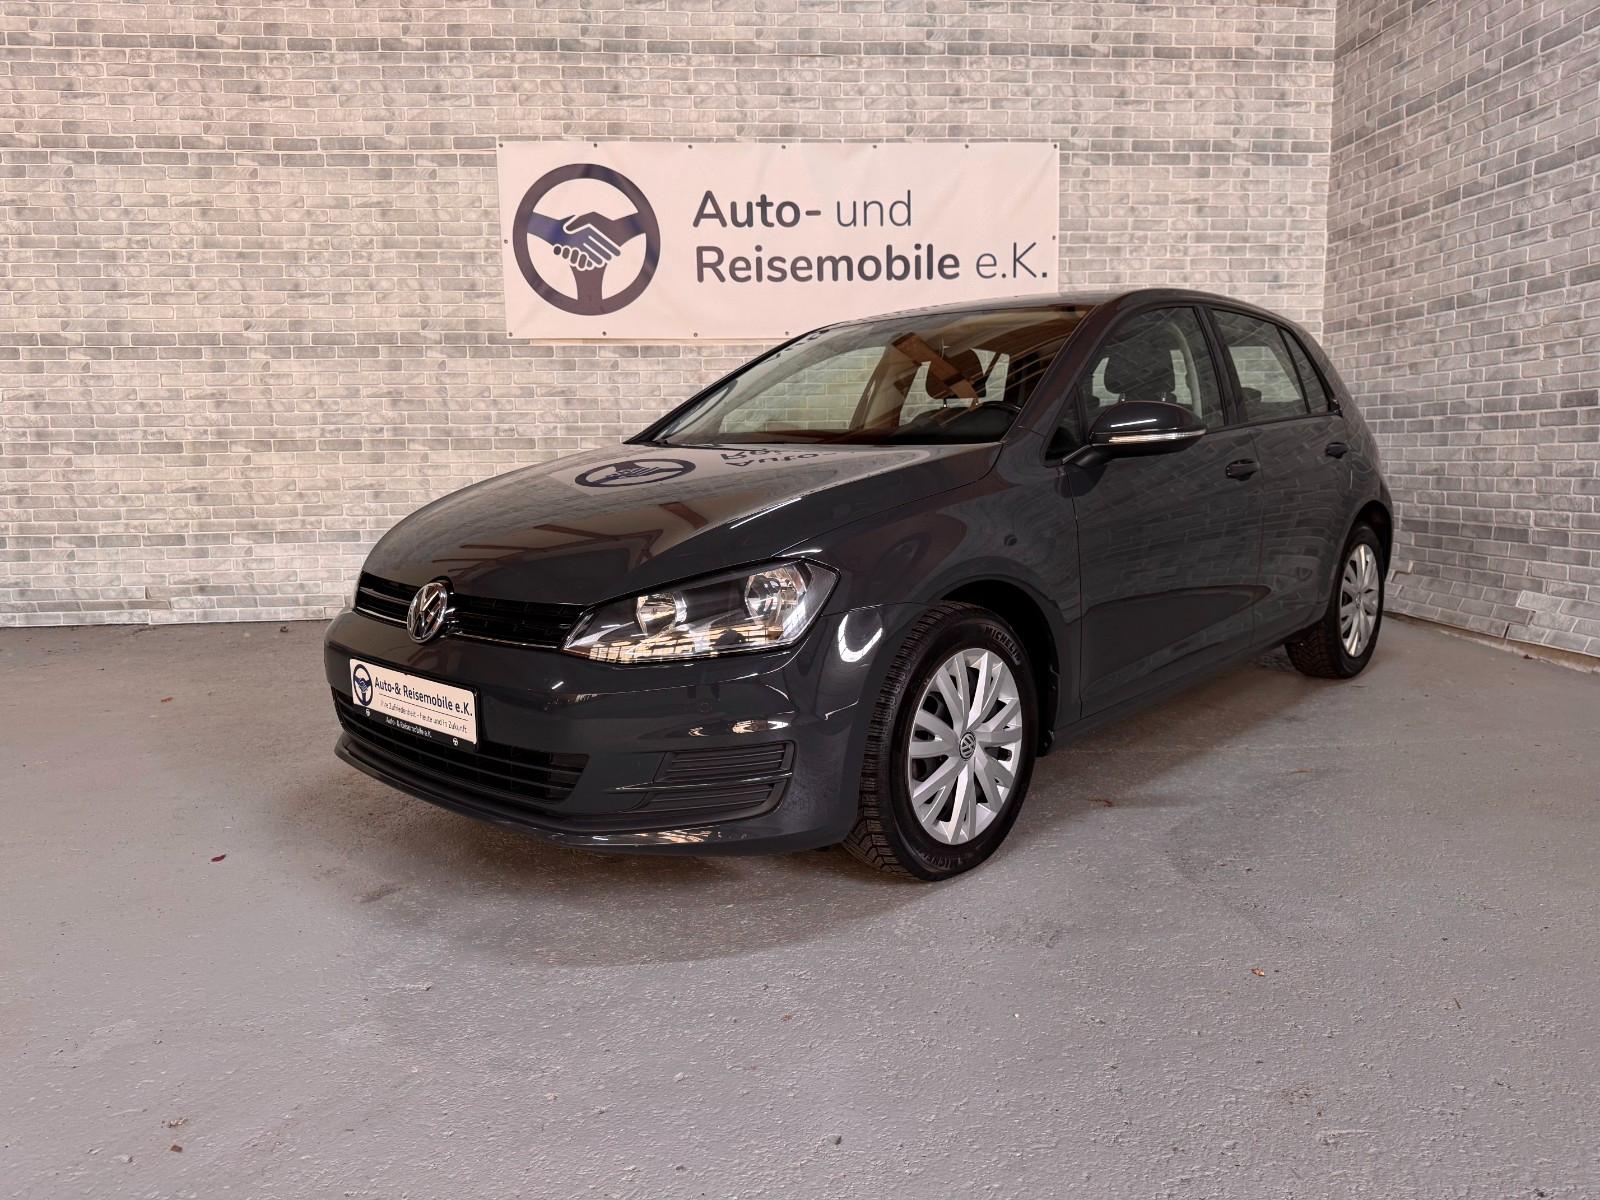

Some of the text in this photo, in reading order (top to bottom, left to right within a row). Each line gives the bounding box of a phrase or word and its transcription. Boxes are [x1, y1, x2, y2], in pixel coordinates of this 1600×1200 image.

[693, 189, 912, 228] Auto- und
[696, 241, 1049, 283] Reisemobile e.K.
[403, 685, 453, 711] Reisemobile
[453, 702, 473, 717] e.K.
